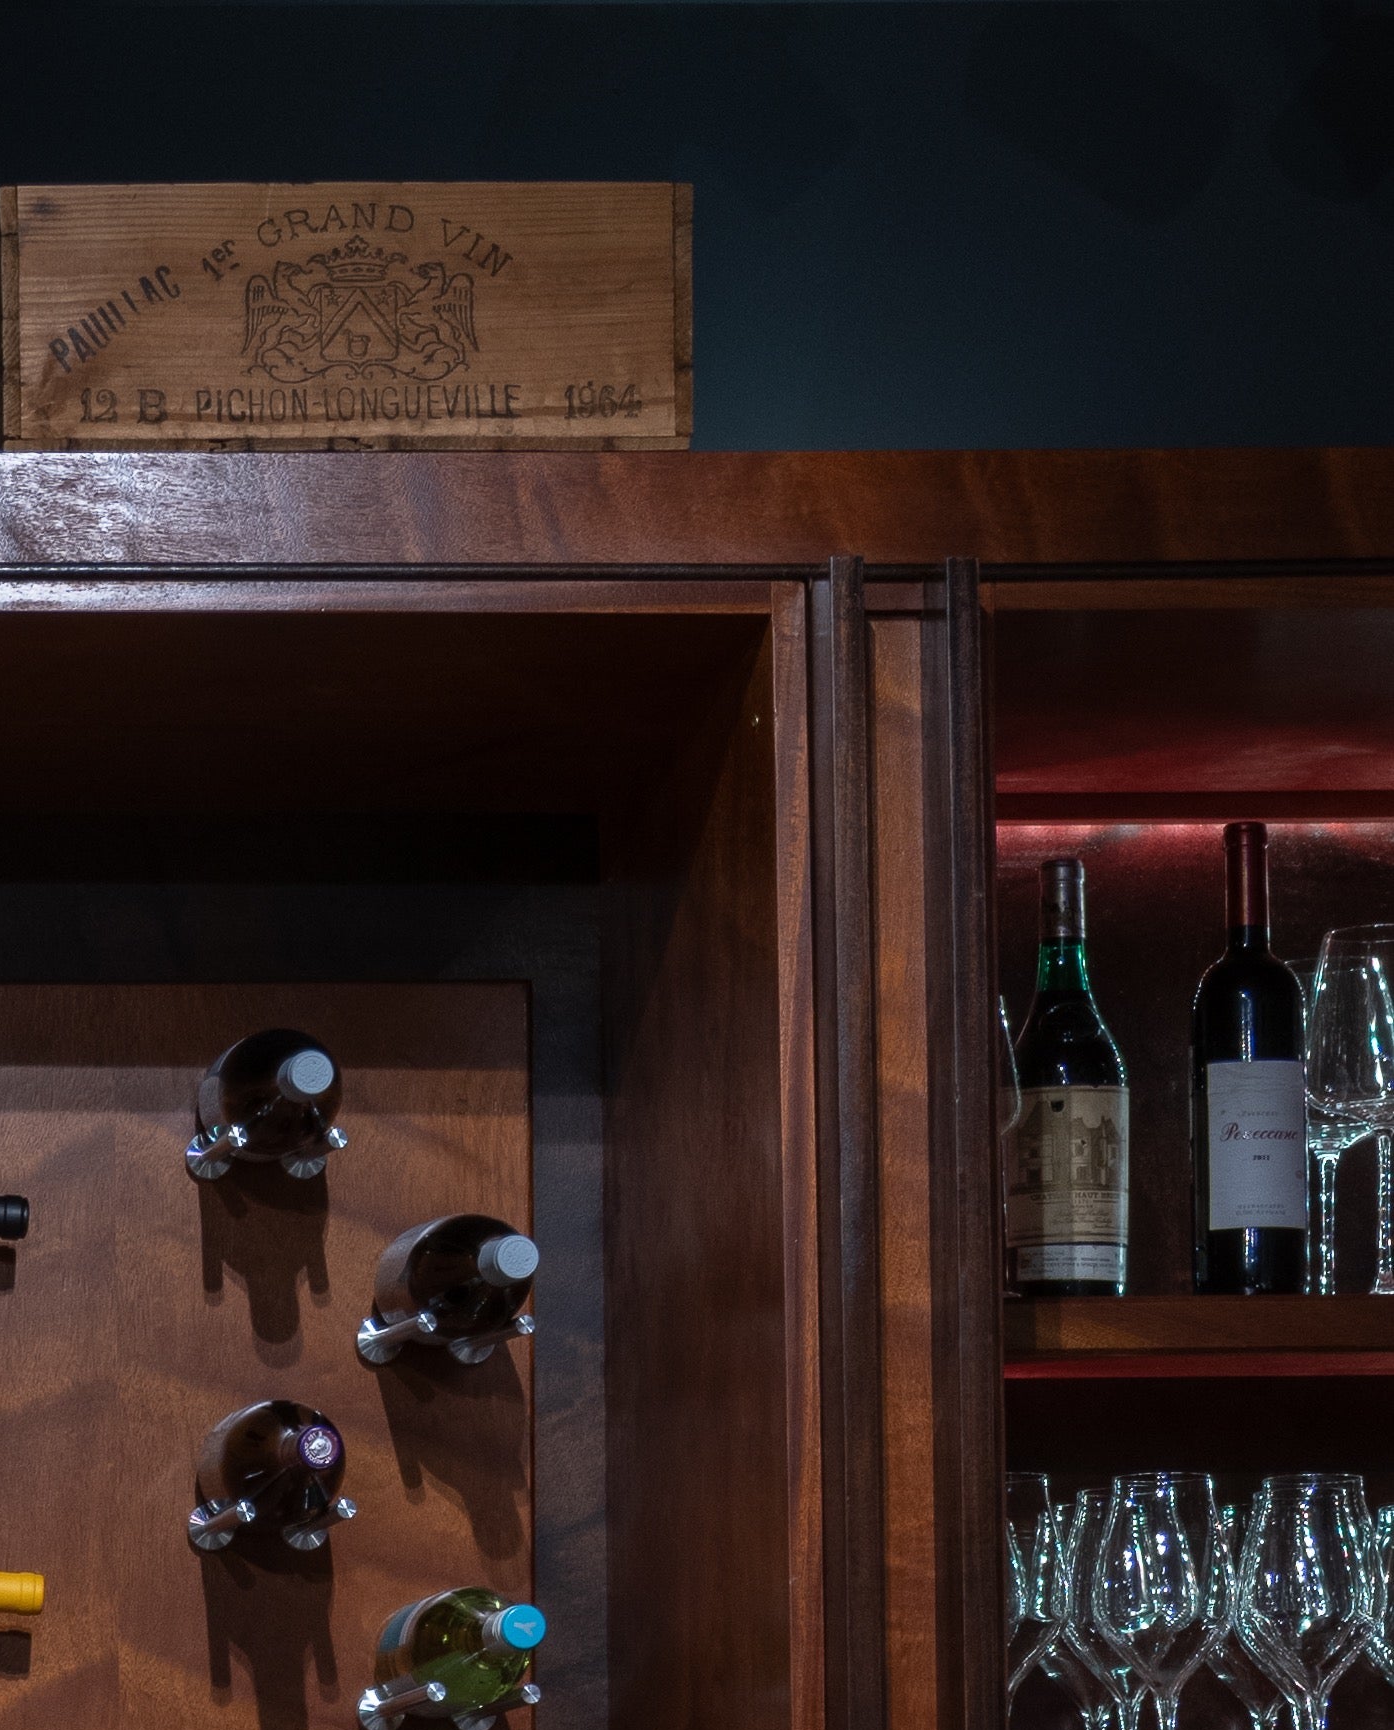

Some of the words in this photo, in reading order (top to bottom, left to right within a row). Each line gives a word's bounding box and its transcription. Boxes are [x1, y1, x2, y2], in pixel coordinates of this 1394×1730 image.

[257, 202, 415, 248] GRAND
[439, 217, 514, 279] VIN
[79, 387, 118, 424] 12
[136, 388, 169, 425] B
